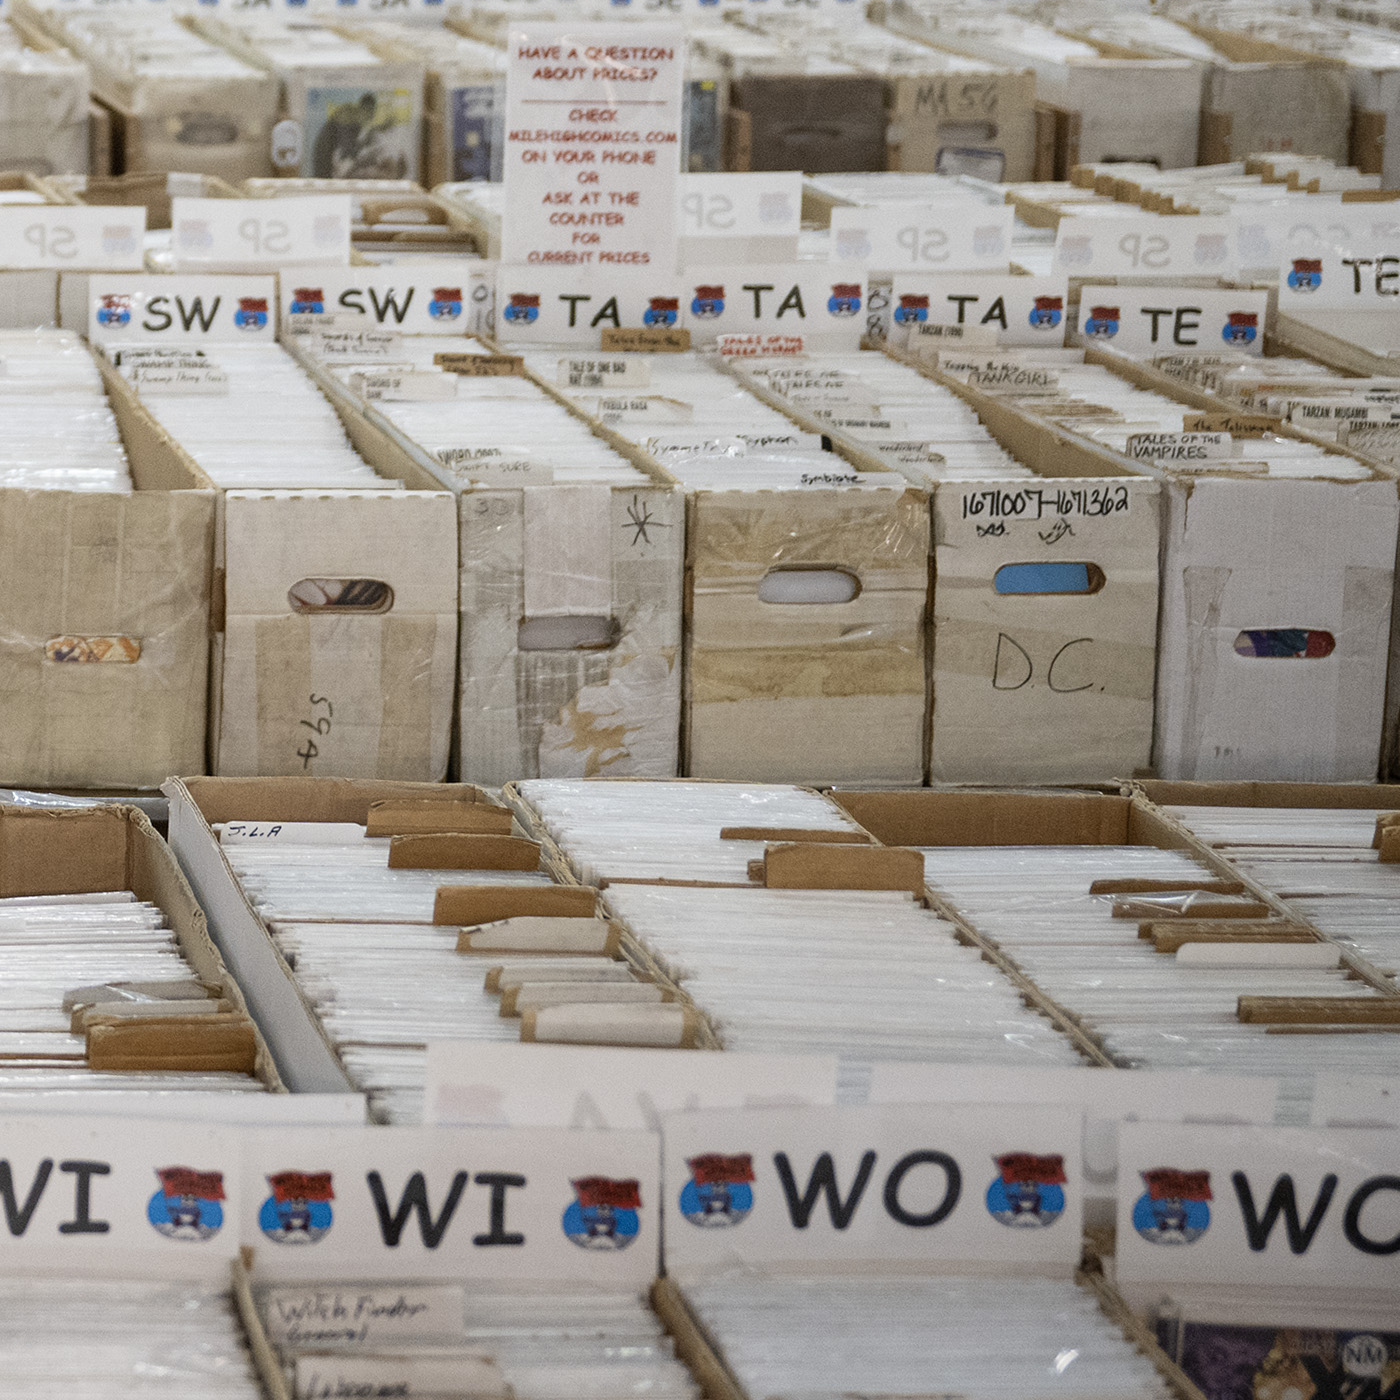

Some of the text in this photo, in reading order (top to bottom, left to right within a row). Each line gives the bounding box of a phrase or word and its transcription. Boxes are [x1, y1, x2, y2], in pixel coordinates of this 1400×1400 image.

[518, 46, 675, 61] HAVE A QUESTION
[532, 67, 587, 81] ABOUT
[568, 108, 618, 122] CHECK
[521, 151, 656, 165] ON YOUR PHONE
[577, 171, 599, 184] OR
[542, 192, 640, 206] ASK AT THE
[549, 212, 625, 226] COUNTER
[571, 232, 601, 246] FOR
[527, 250, 651, 264] CURRENT PRICES
[1342, 256, 1400, 298] TE
[338, 287, 416, 324] SW
[742, 284, 806, 319] TA
[142, 295, 222, 333] SW
[558, 294, 622, 330] TA
[947, 295, 1009, 331] TA
[1140, 306, 1203, 346] TE
[1136, 434, 1221, 445] TALES OF THE
[1134, 445, 1209, 460] VAMPIRES
[773, 1149, 964, 1232] WO
[366, 1170, 527, 1251] WI
[1231, 1171, 1400, 1257] WO
